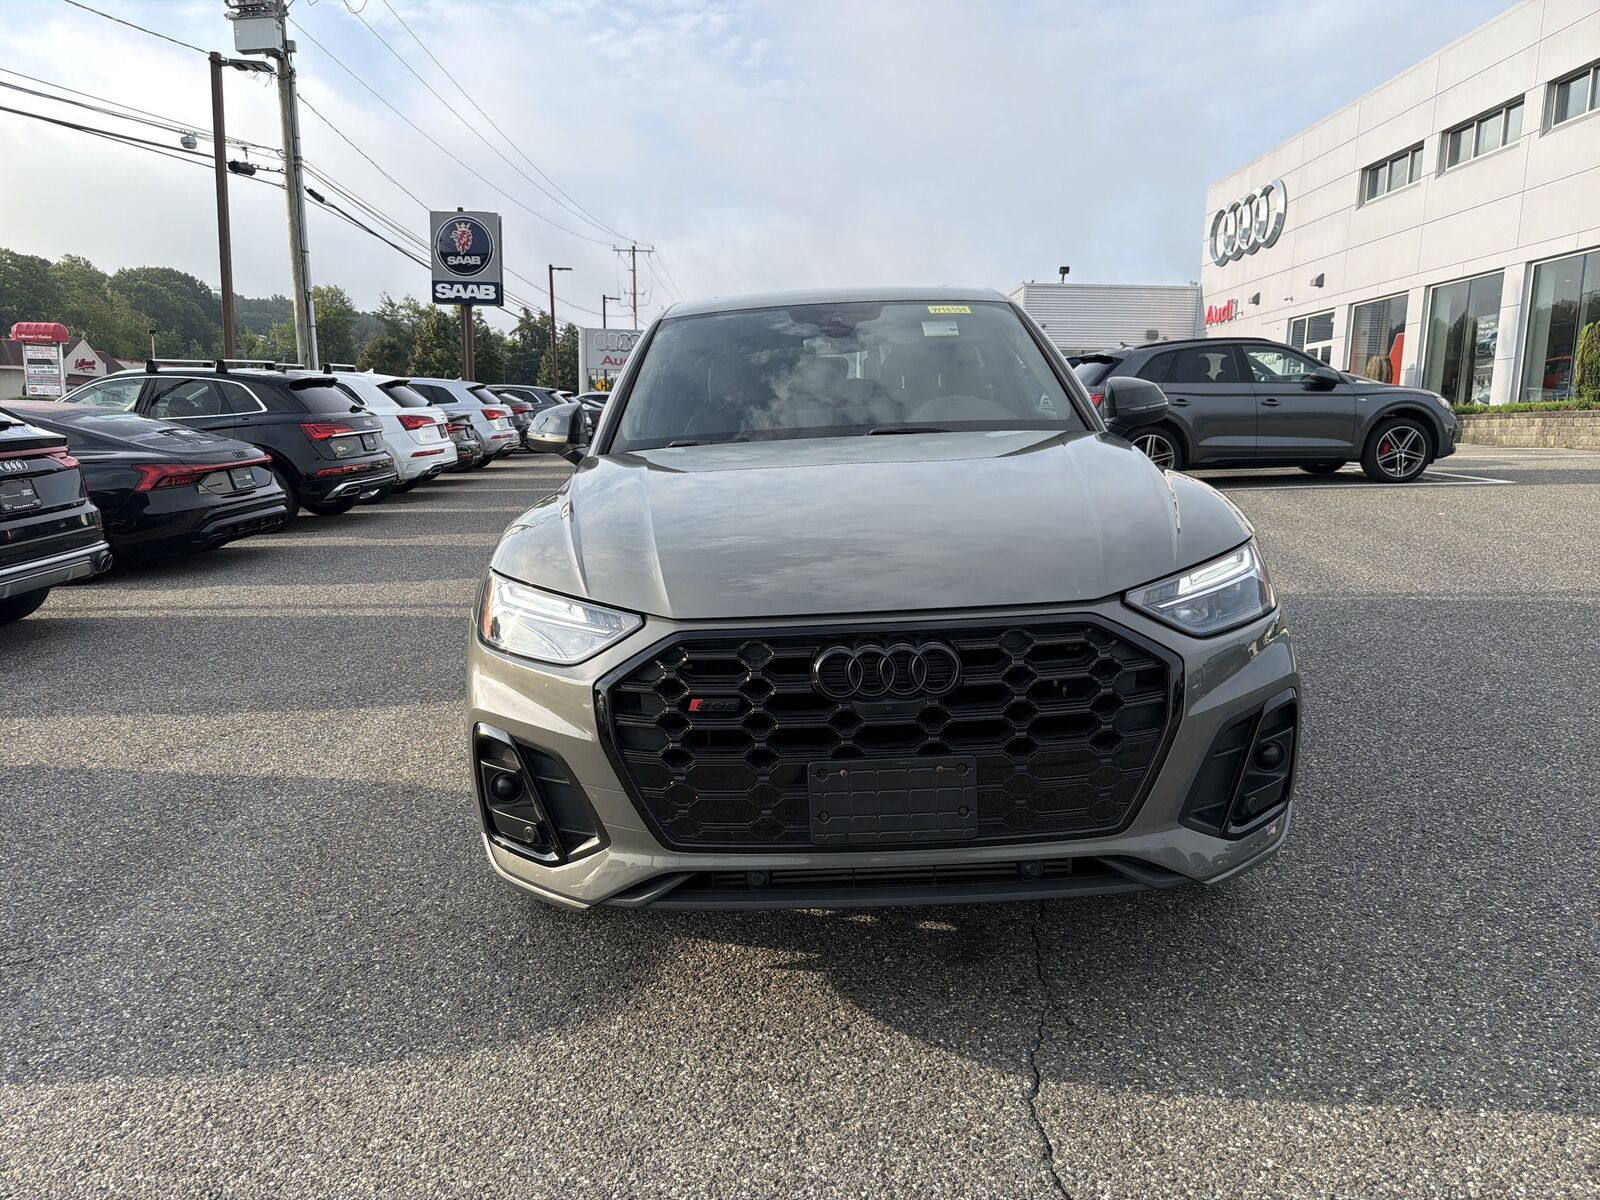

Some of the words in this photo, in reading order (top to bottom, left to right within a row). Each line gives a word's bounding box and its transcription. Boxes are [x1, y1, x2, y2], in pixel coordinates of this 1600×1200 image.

[447, 255, 481, 265] SAAB
[435, 283, 496, 299] SAAB
[1204, 299, 1233, 324] Audi
[601, 355, 630, 366] Au
